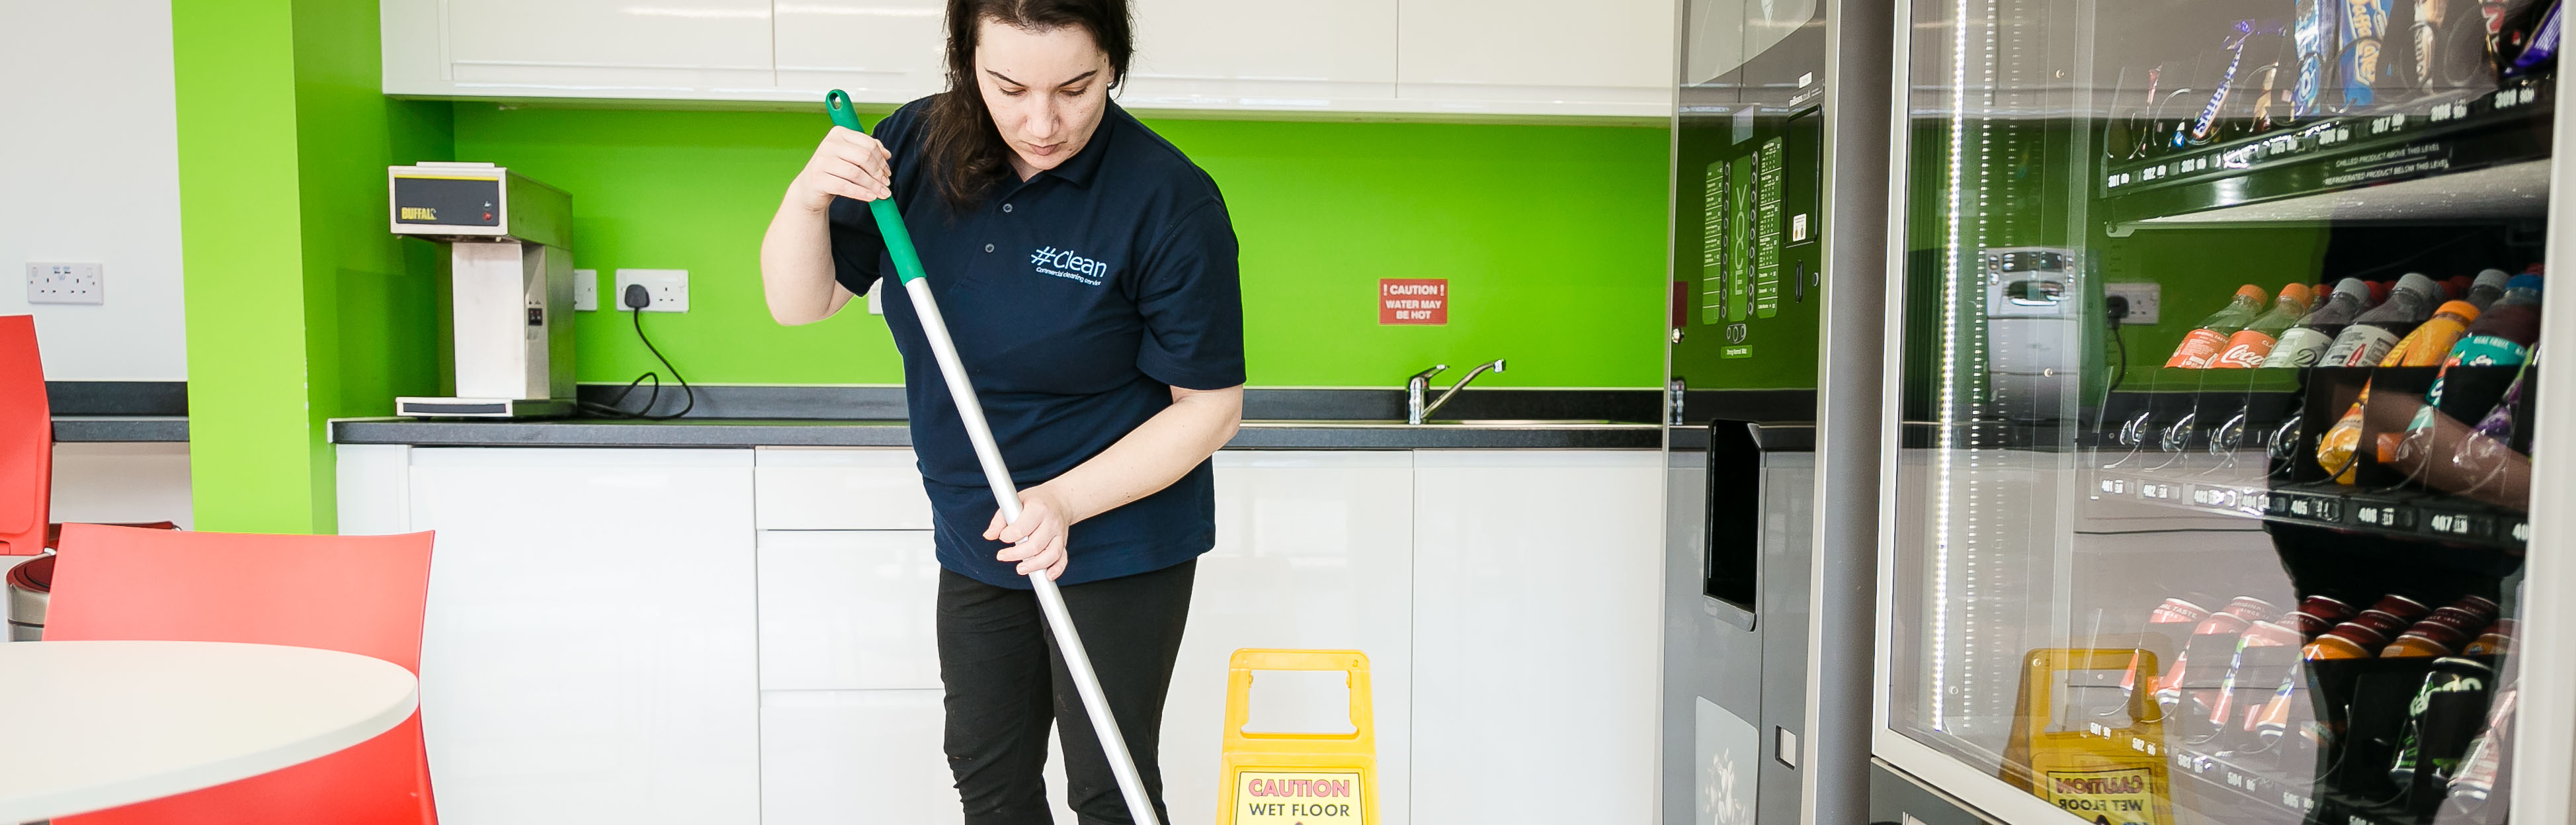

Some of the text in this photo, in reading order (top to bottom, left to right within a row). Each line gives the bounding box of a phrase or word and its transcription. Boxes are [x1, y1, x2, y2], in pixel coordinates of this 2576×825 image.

[2372, 116, 2390, 134] 307
[2358, 152, 2386, 163] PRODUCT
[2407, 146, 2421, 155] THIS
[2415, 161, 2430, 171] THIS
[1735, 184, 1747, 296] VOCE
[1030, 245, 1107, 278] #Clean
[1390, 284, 1438, 295] CAUTION
[1386, 300, 1442, 309] WATER MAY
[1396, 310, 1432, 320] BE HOT
[2220, 344, 2265, 369] Coca
[2290, 499, 2307, 515] 405
[2431, 515, 2452, 532] 407
[2512, 523, 2530, 541] 40
[2173, 604, 2198, 620] TASTE
[2240, 607, 2260, 617] SINCE
[2090, 722, 2101, 736] 501
[2132, 737, 2145, 752] 502
[2227, 771, 2242, 787] 504
[1248, 779, 1350, 798] CAUTION
[1249, 803, 1350, 817] WET FLOOR
